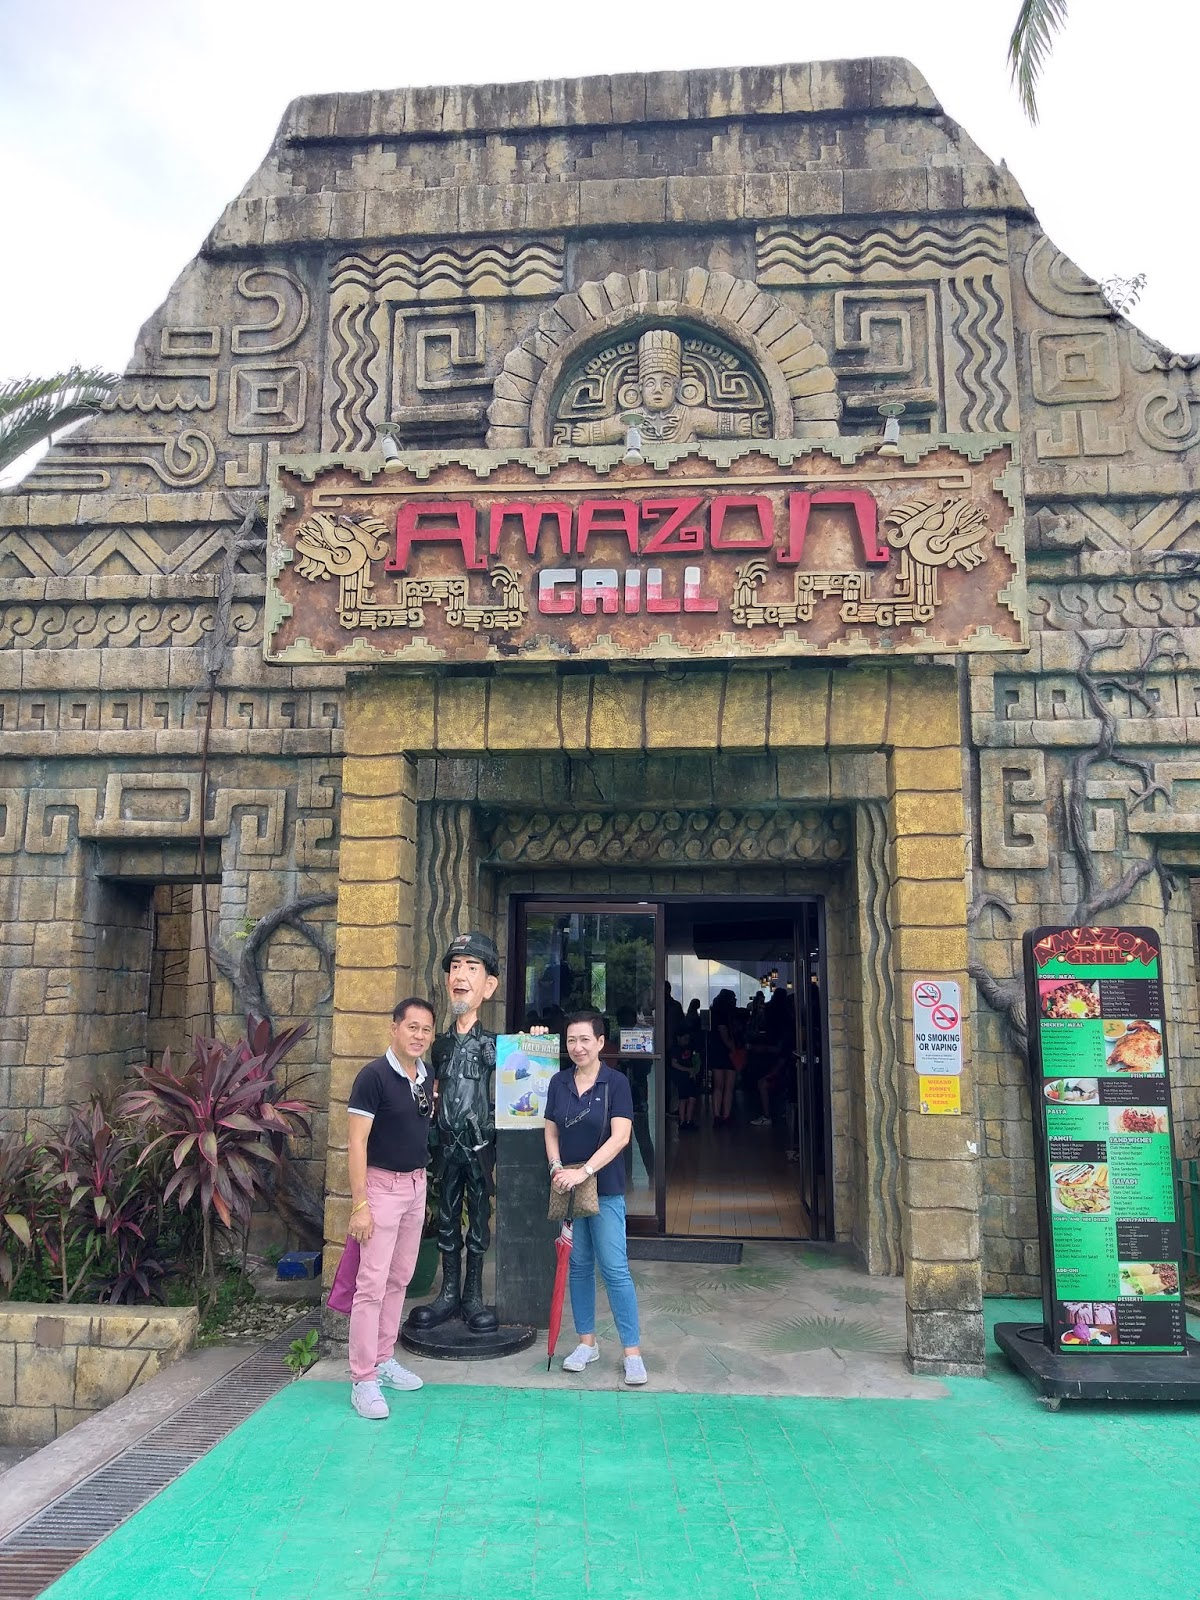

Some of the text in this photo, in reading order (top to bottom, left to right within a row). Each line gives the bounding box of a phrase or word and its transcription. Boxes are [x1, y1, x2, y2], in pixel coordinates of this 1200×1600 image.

[385, 491, 889, 572] AMAZON
[537, 567, 719, 616] GRILL
[1033, 927, 1158, 967] AMAZON
[1064, 949, 1129, 965] GRILL
[916, 1033, 959, 1042] NO SMOKING
[522, 1041, 560, 1054] HALO HALO
[919, 1043, 957, 1051] OR VAPING
